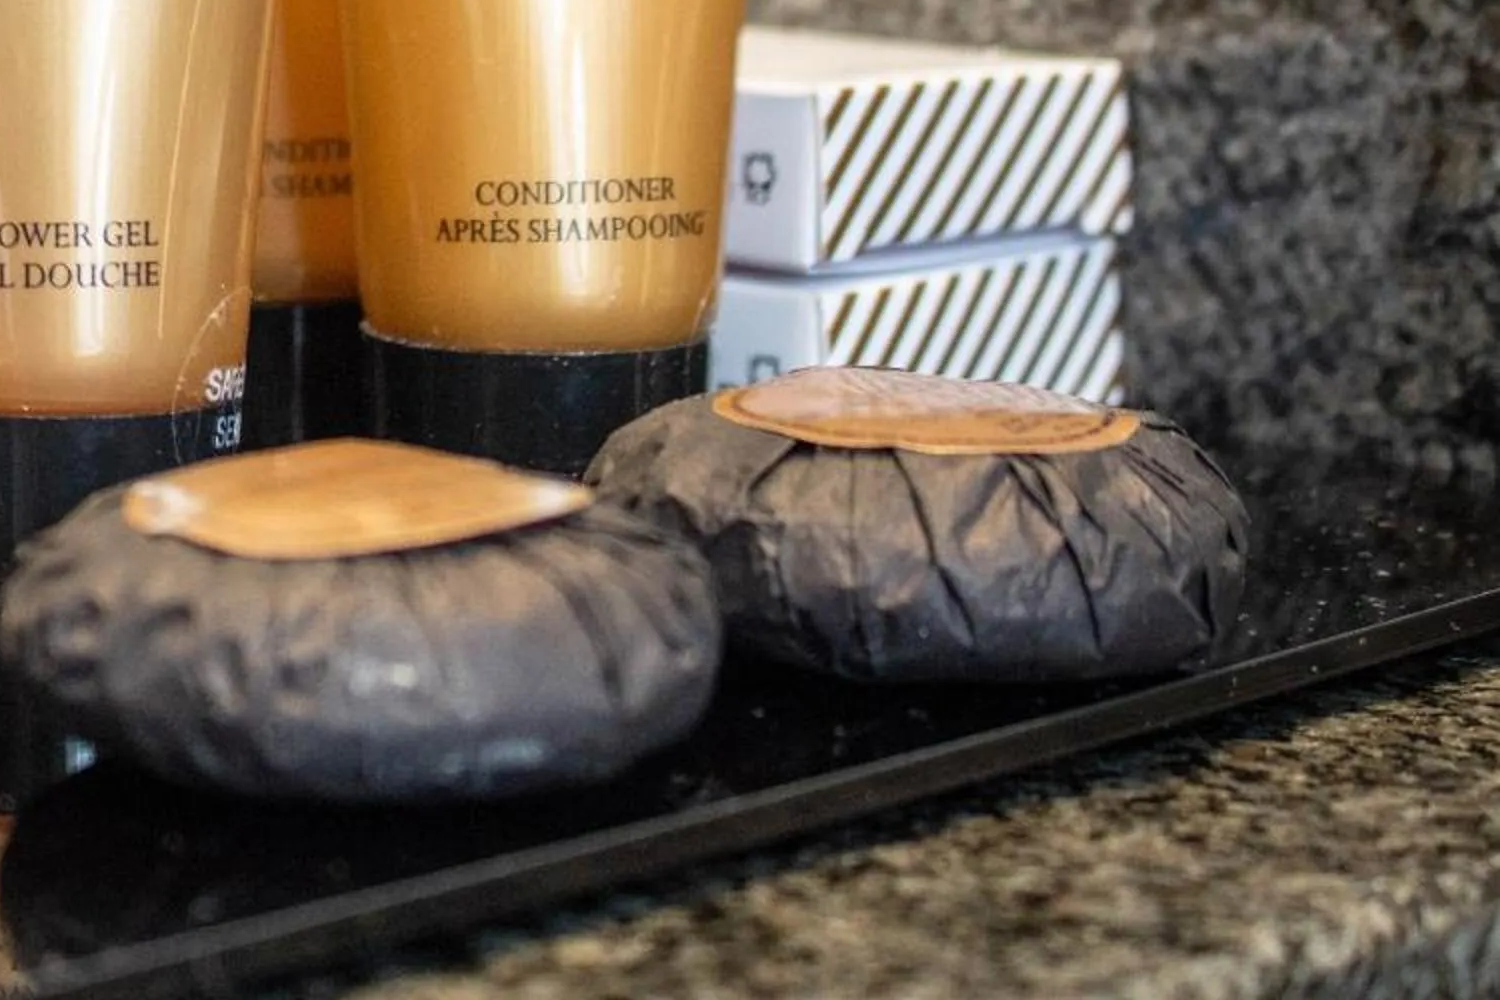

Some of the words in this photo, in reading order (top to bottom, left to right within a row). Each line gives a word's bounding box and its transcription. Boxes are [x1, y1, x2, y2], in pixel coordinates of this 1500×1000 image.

[474, 176, 676, 208] CONDITIONER
[102, 219, 161, 248] GEL
[435, 210, 522, 245] APRÈS
[526, 210, 707, 244] SHAMPOOING
[22, 259, 162, 291] DOUCHE
